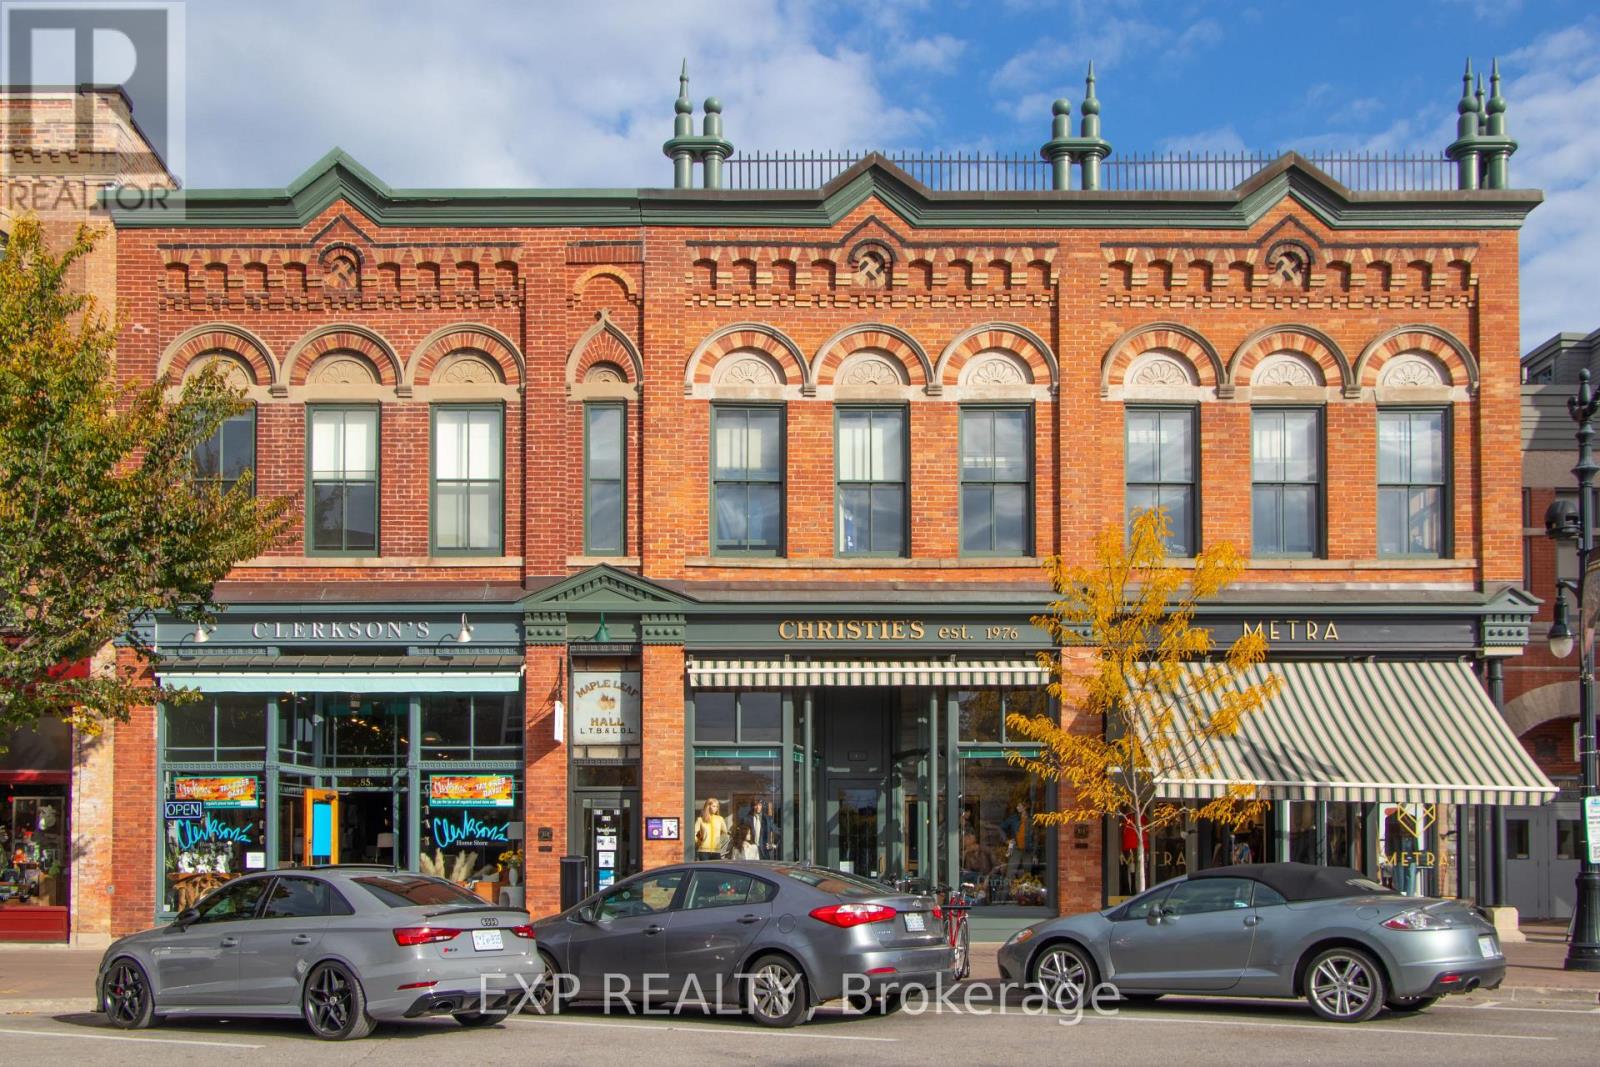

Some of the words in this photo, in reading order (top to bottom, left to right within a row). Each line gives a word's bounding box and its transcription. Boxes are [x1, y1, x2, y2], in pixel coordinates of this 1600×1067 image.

[252, 621, 432, 640] CLERKSON'S
[778, 620, 926, 640] CHRISTIE'S
[937, 624, 974, 640] est.
[984, 625, 1019, 640] 1976
[1243, 619, 1340, 641] METRA
[575, 679, 611, 698] MAPLE
[612, 680, 639, 697] LEAF
[590, 717, 625, 727] HALL
[166, 803, 200, 816] OPEN
[473, 839, 488, 847] Store
[1119, 851, 1187, 866] MTRA
[1379, 851, 1449, 867] METRA
